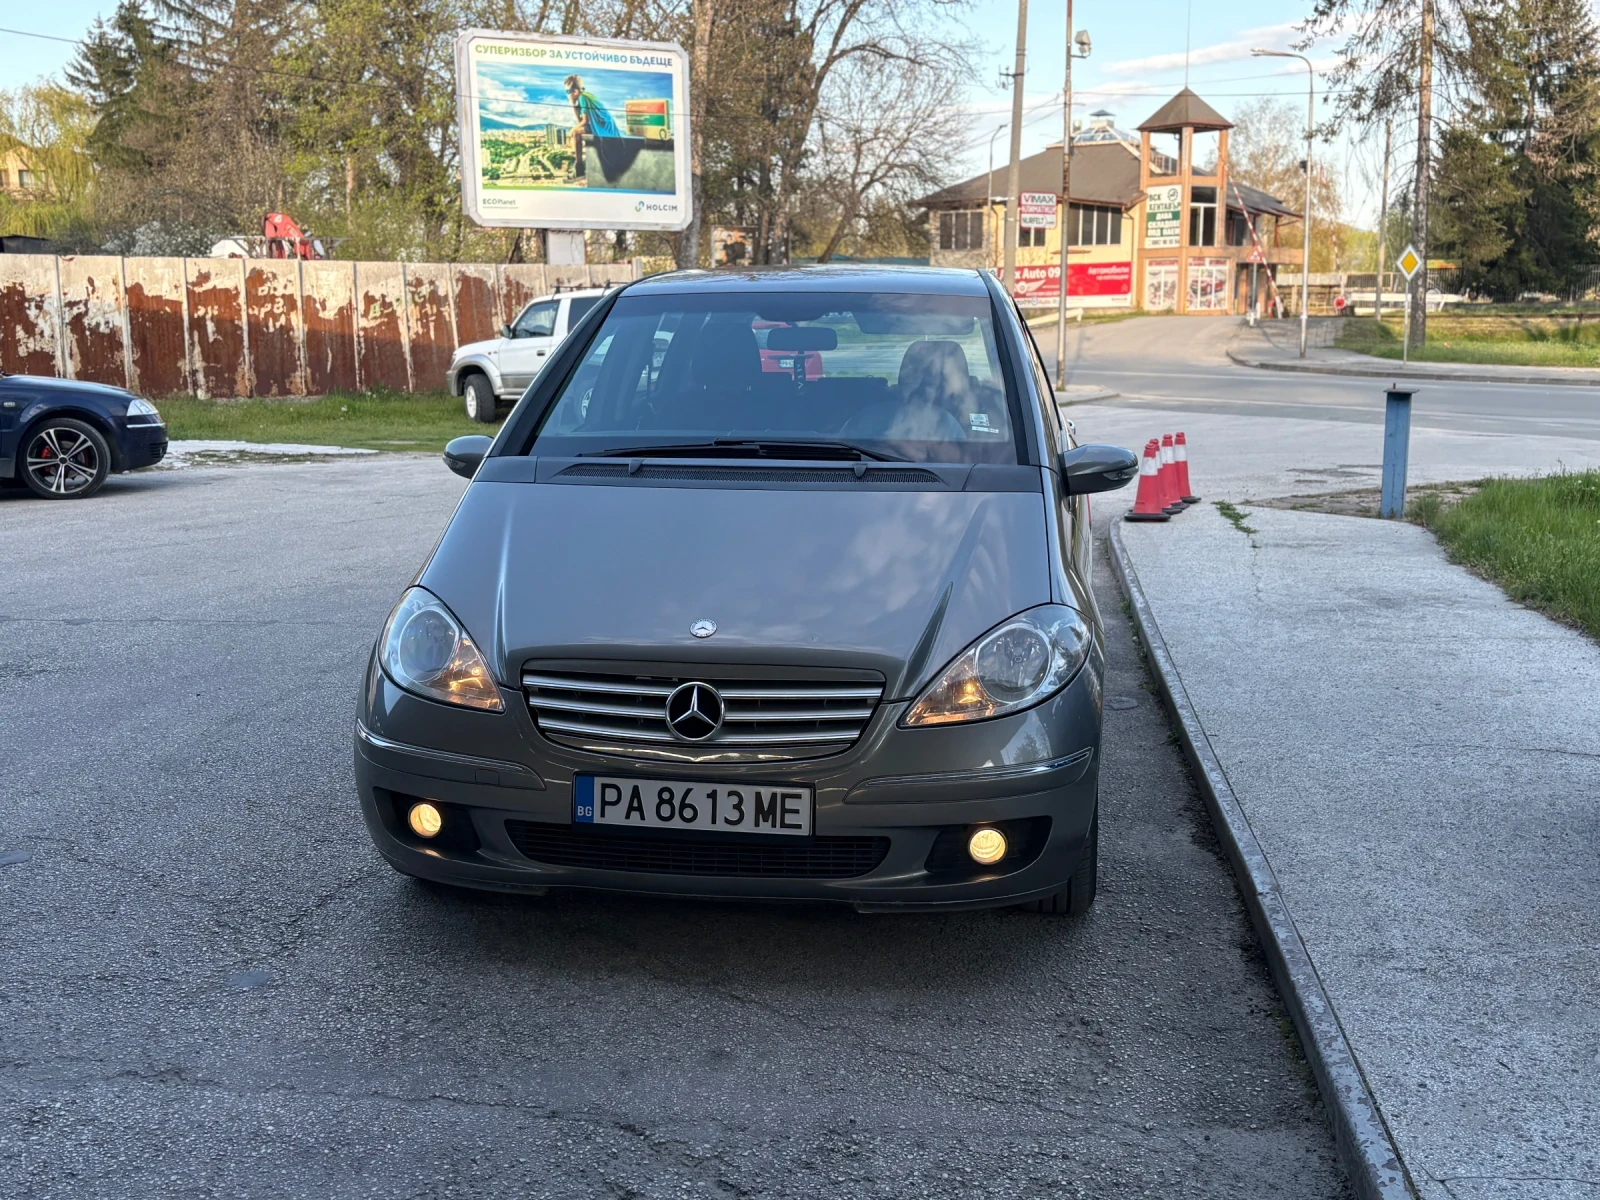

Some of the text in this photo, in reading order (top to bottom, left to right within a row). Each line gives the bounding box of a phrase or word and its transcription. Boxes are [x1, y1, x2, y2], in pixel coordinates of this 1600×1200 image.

[475, 44, 673, 67] СУПЕРИЗБОР ЗА УСТОЙЧИВО БЪДЕЩЕ
[482, 198, 516, 206] ECOPlanet
[1023, 194, 1055, 204] VIMAX
[646, 203, 678, 212] HOLCIM
[1022, 217, 1044, 225] NURFELT
[1022, 268, 1046, 280] Auto
[577, 805, 593, 817] BG
[599, 783, 803, 830] PA 8613 ME
